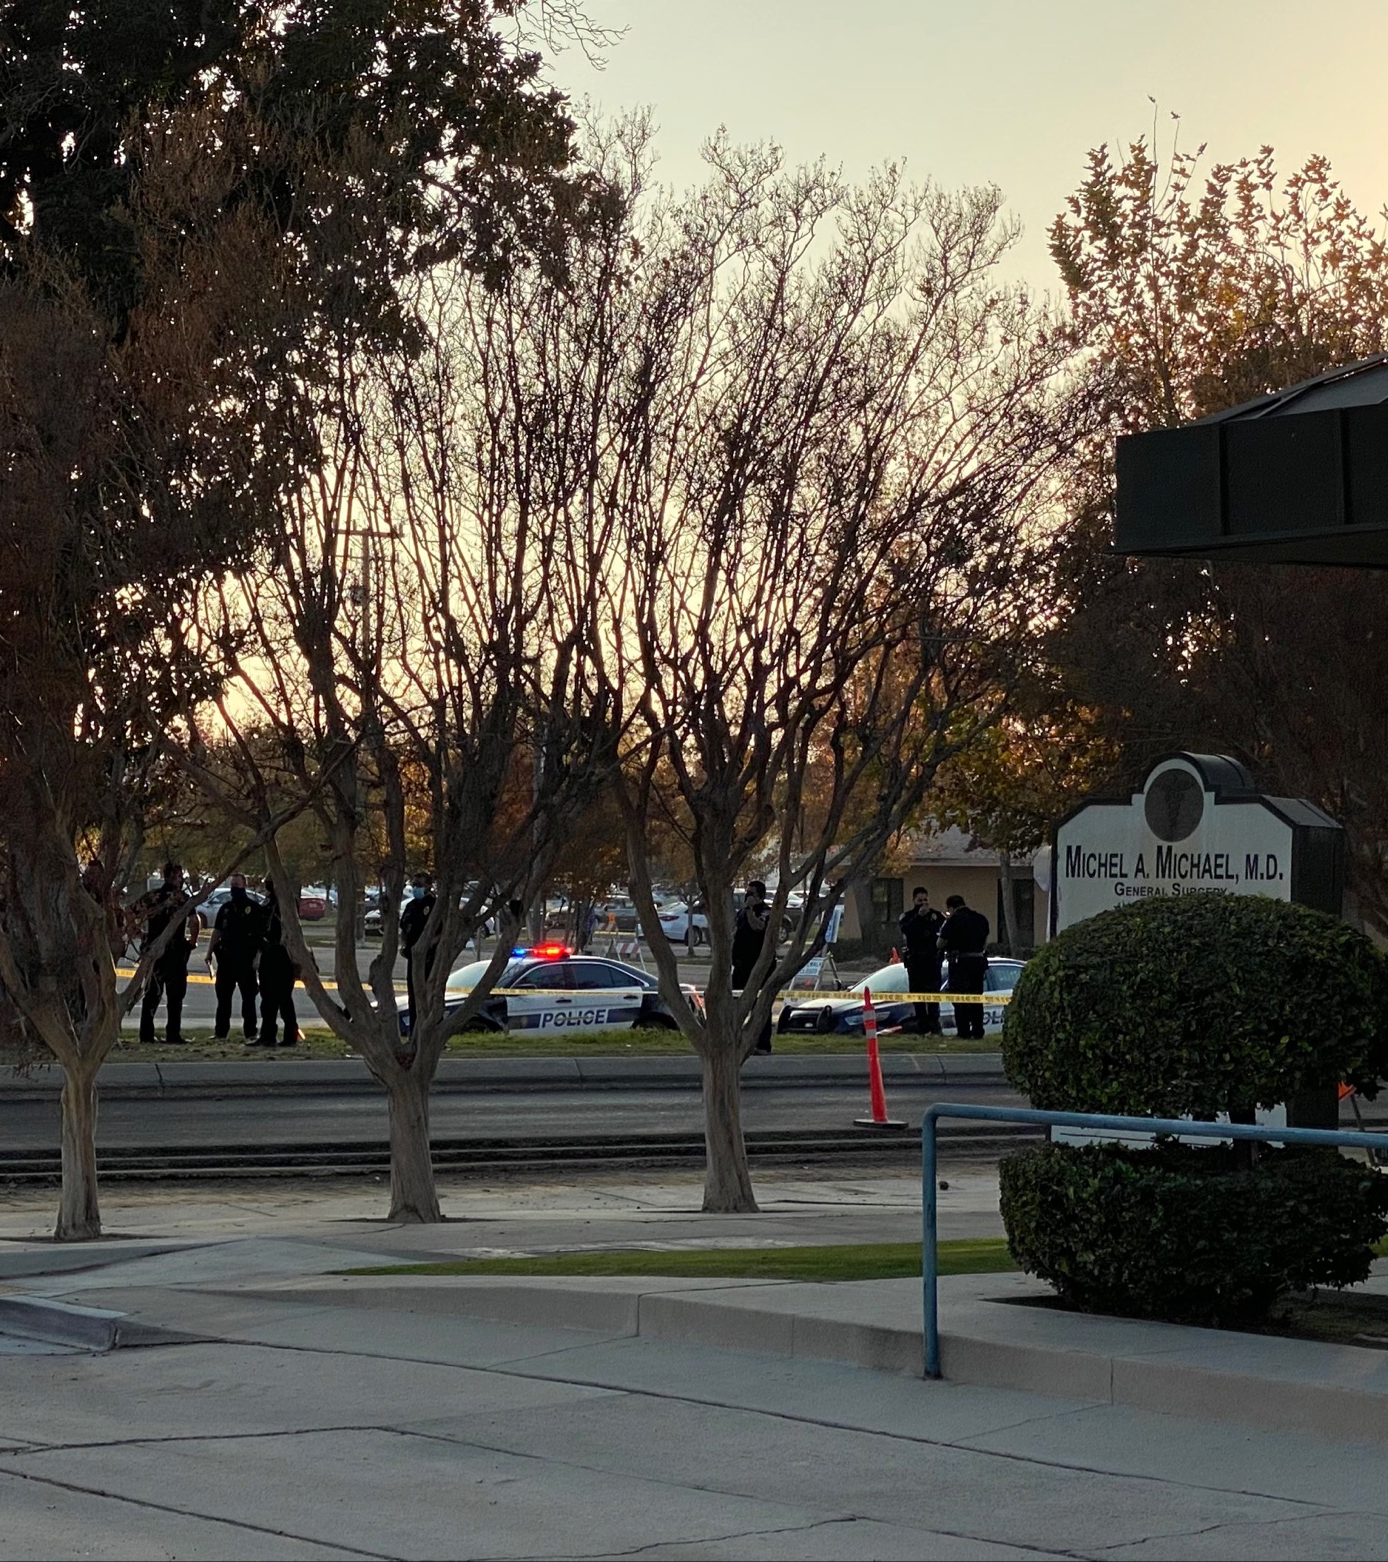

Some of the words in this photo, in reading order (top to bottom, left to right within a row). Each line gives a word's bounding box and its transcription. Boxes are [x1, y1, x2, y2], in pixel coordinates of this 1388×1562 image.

[1134, 853, 1150, 880] A.
[1244, 853, 1284, 880] M.D.
[542, 1009, 606, 1028] POLICE
